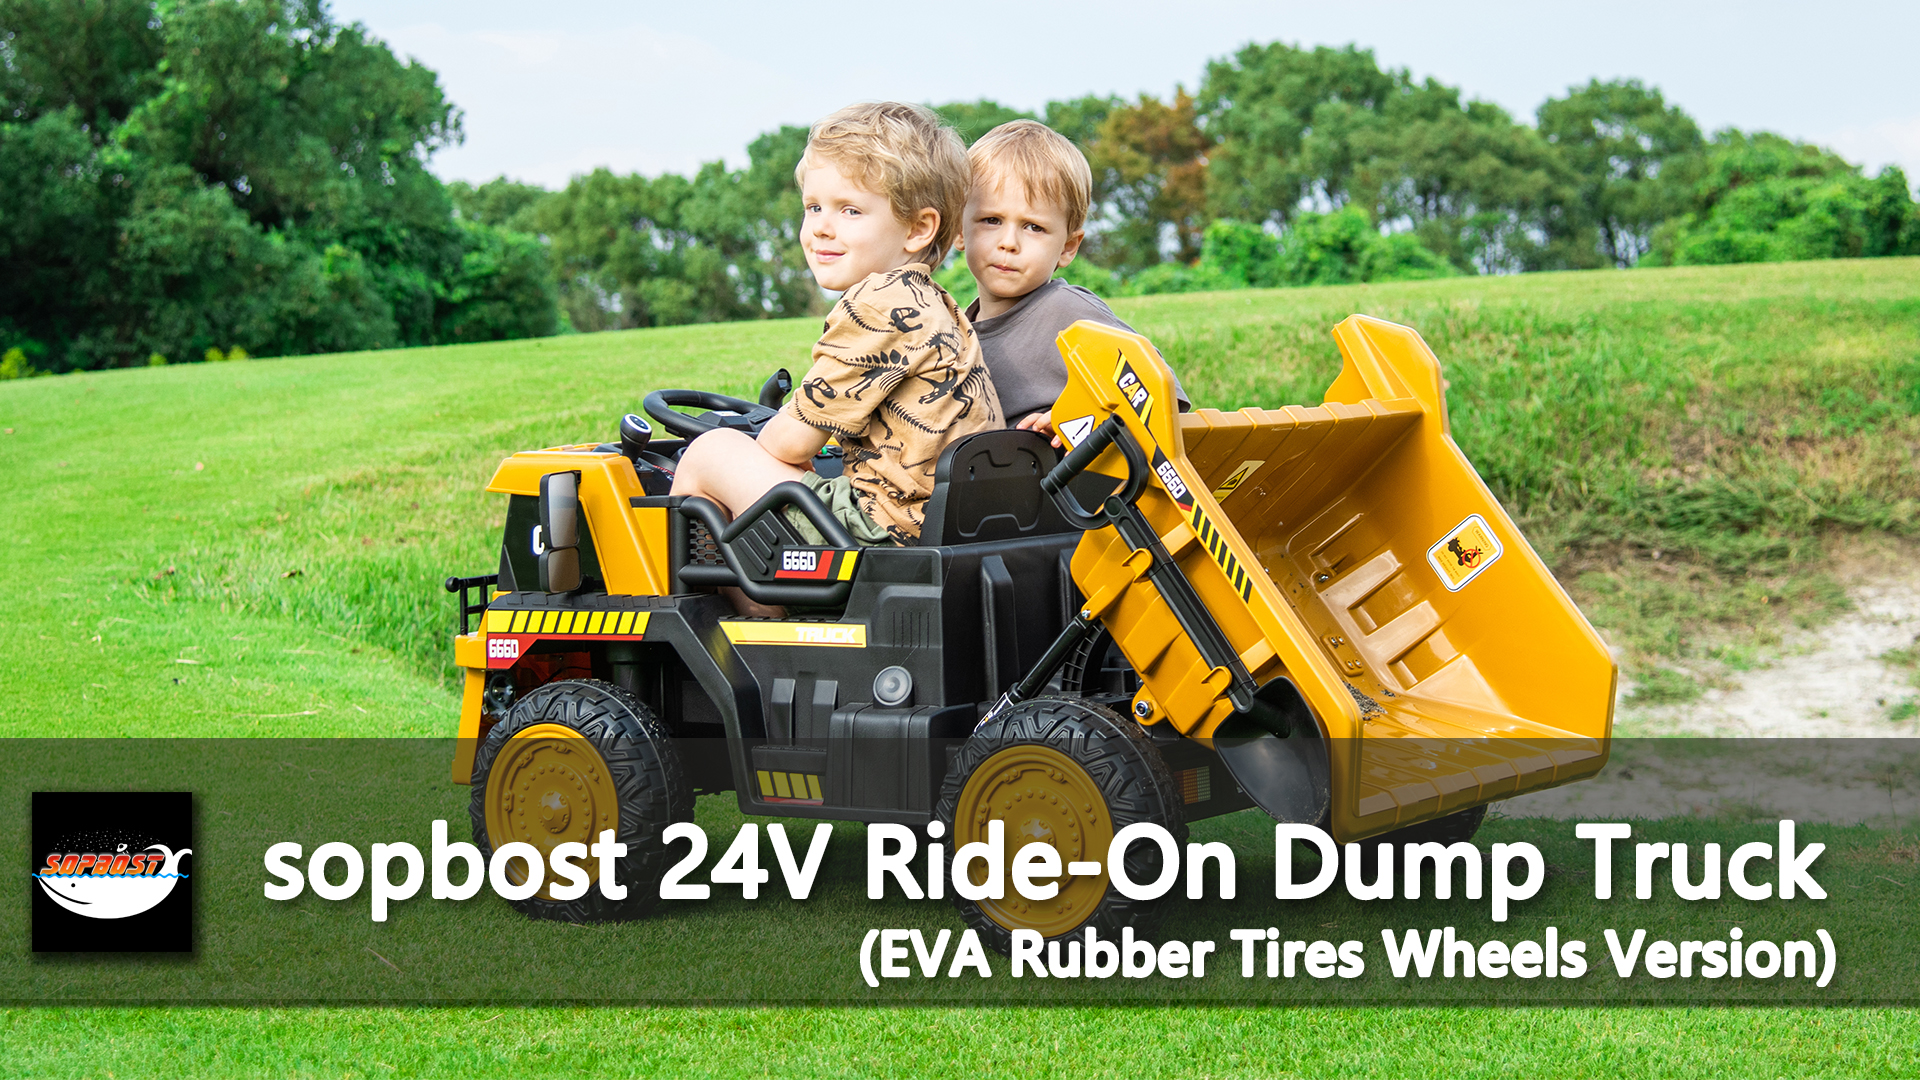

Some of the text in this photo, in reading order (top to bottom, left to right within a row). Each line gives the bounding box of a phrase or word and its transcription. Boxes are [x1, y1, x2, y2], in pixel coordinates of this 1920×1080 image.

[1118, 372, 1148, 408] CAR
[1156, 460, 1187, 500] 666D
[783, 550, 817, 571] 666D
[795, 627, 856, 644] TRUCK
[488, 638, 519, 659] 666D
